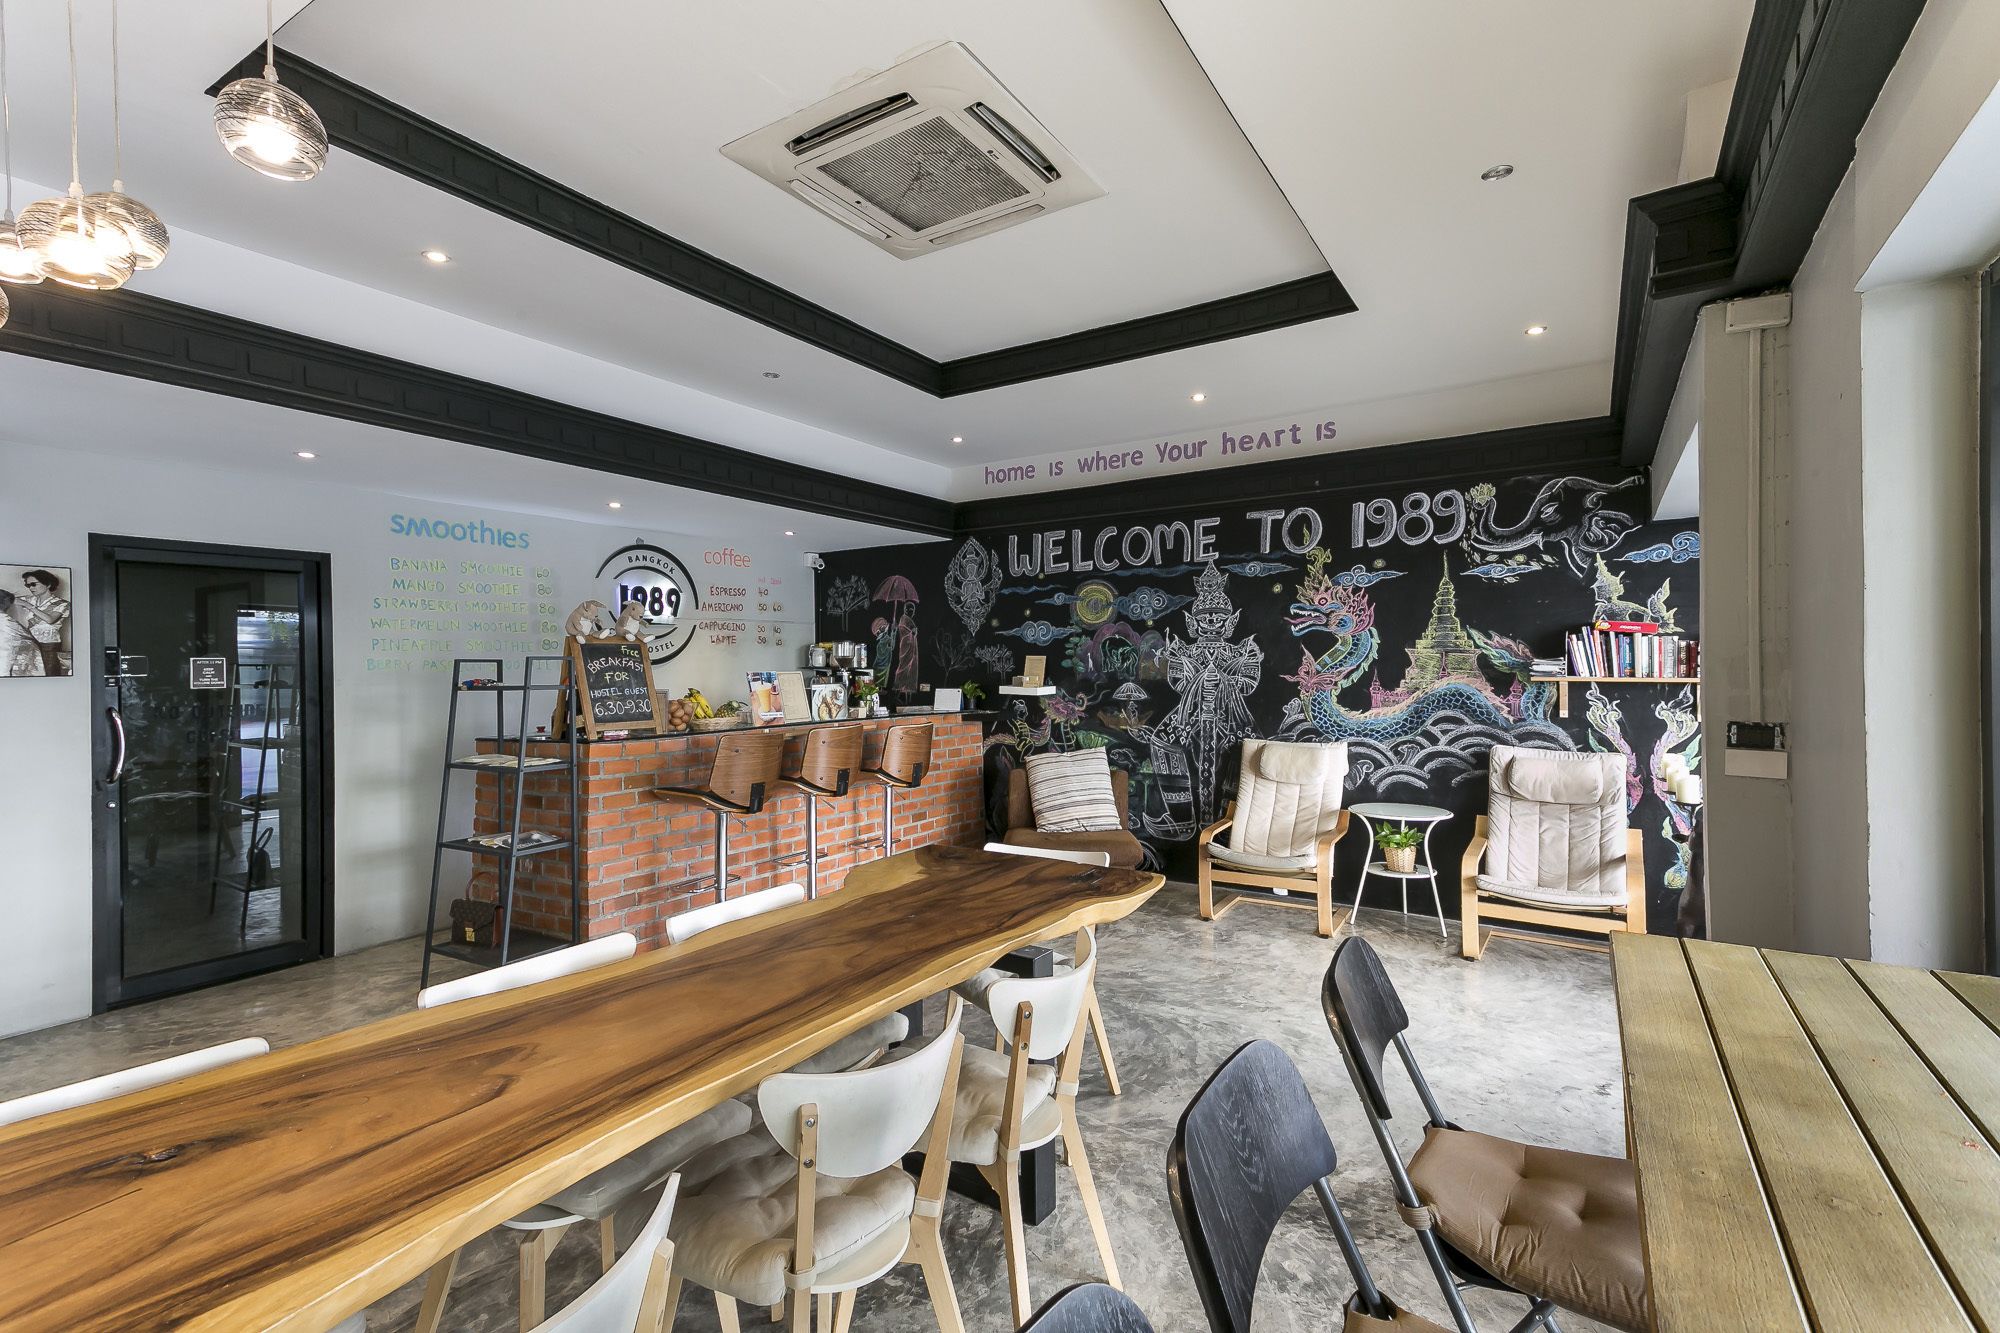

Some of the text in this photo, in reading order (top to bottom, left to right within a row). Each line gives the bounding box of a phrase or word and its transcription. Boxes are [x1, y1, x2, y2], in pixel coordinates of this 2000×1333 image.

[984, 462, 1036, 485] home
[1048, 460, 1064, 479] is
[1077, 449, 1144, 474] where
[1316, 420, 1337, 442] is
[1008, 488, 1467, 577] WELCOME TO 1989
[390, 557, 448, 572] BANANA
[460, 561, 524, 577] SMOOTHIE
[627, 554, 676, 575] BANGKOK
[704, 548, 751, 568] coffee
[392, 578, 552, 596] MANGO SMOOTHIE 80
[709, 586, 747, 597] ESPRESSO
[373, 597, 459, 612] STRAWBERRY
[539, 602, 556, 615] 80
[619, 583, 681, 617] 1989
[701, 602, 744, 612] AMERICANO
[758, 603, 768, 612] 50
[370, 618, 558, 633] WATERMELON SMOOTHIE 80
[372, 638, 453, 653] PINEAPPLE
[542, 639, 559, 650] 80
[621, 646, 640, 657] Free
[648, 640, 675, 653] OSTEL
[587, 656, 644, 674] BREAKFAST
[604, 671, 630, 684] FOR
[590, 687, 648, 699] HOSTEL GUEST
